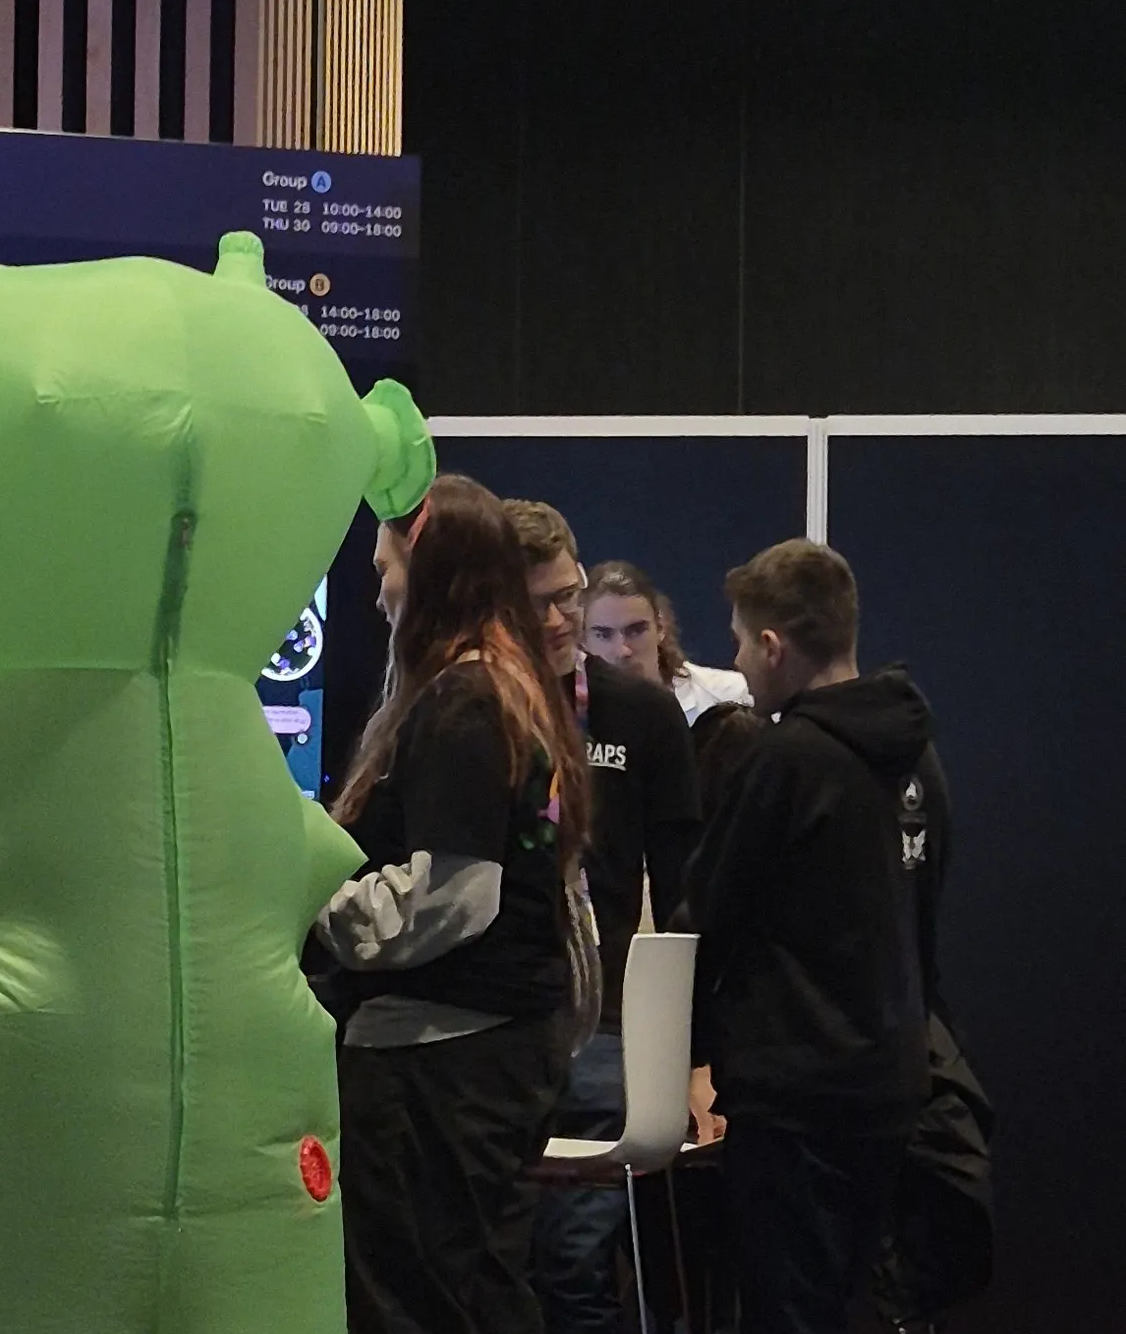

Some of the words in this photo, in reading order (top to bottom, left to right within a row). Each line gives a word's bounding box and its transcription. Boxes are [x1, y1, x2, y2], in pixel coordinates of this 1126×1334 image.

[262, 171, 308, 191] Group
[262, 199, 288, 213] TUE
[293, 200, 311, 214] 28
[262, 217, 289, 231] THU
[293, 219, 311, 232] 30
